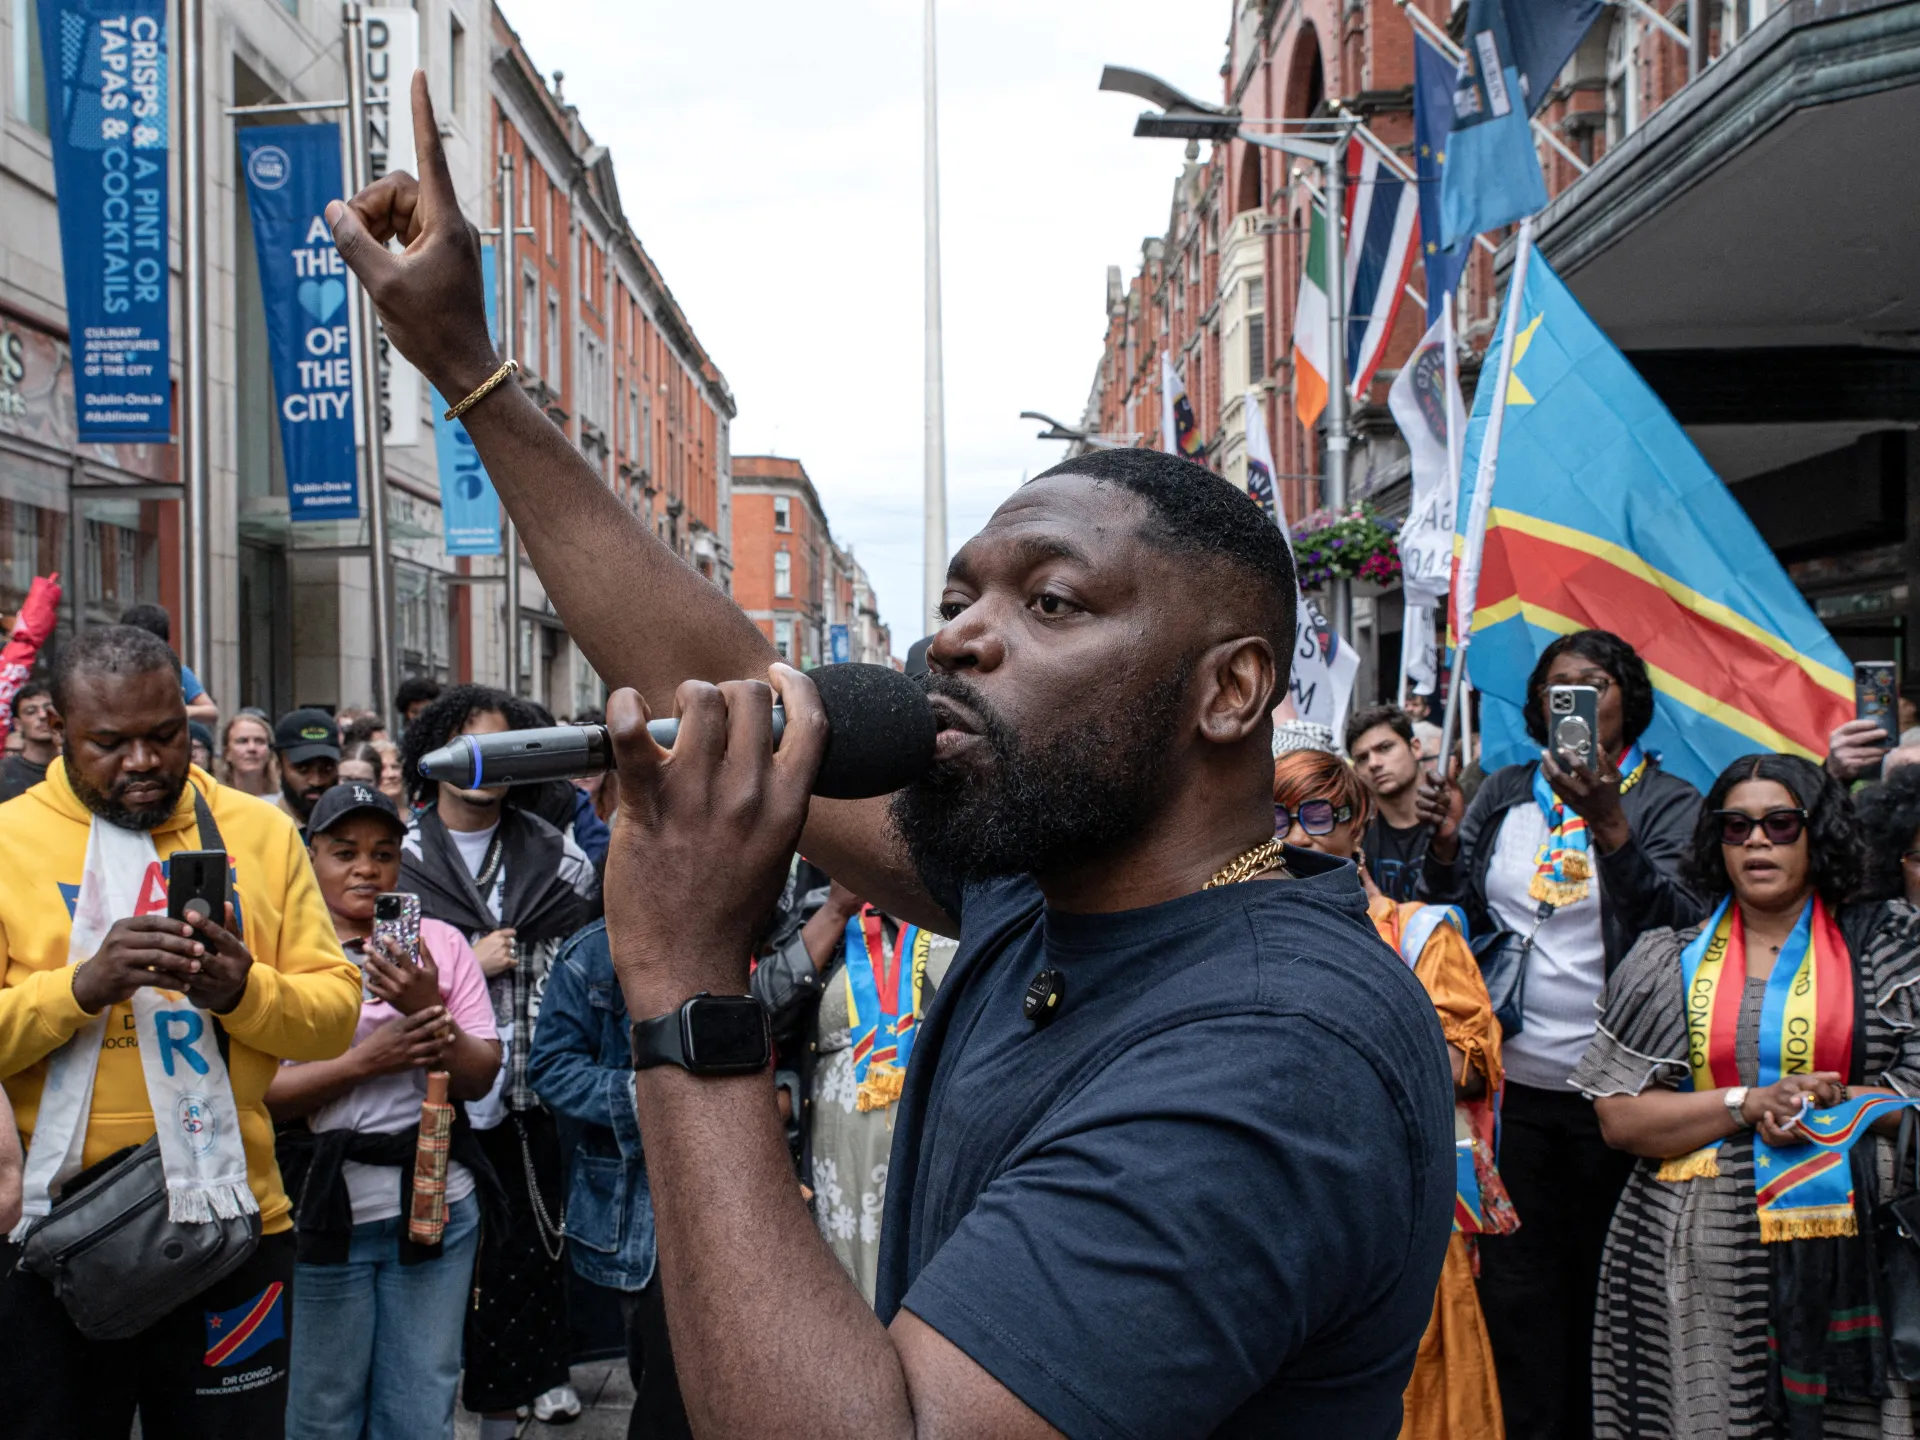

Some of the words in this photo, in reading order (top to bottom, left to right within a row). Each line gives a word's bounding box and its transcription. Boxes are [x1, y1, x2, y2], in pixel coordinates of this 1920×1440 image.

[100, 15, 128, 111] TAPAS
[131, 16, 159, 118] CRISPS
[366, 20, 389, 180] DUNNE
[102, 117, 129, 140] &
[132, 124, 160, 149] &
[133, 156, 159, 180] A
[102, 146, 130, 314] COCKTAILS
[133, 188, 160, 251] PINT
[305, 216, 335, 244] A
[292, 248, 345, 277] THE
[133, 257, 161, 302] OR
[84, 327, 141, 339] CULINARY
[84, 339, 160, 351] ADVENTURES
[306, 326, 348, 356] OF
[84, 352, 100, 363] AT
[102, 352, 125, 364] THE
[84, 365, 101, 377] OF
[103, 365, 126, 377] THE
[126, 364, 153, 377] CITY
[297, 358, 350, 388] THE
[283, 391, 350, 422] CITY
[353, 785, 373, 802] LA
[1704, 935, 1729, 962] RD
[124, 1014, 136, 1030] D
[1689, 978, 1713, 1069] CONGO
[154, 1010, 210, 1077] R
[1785, 1017, 1809, 1076] CON
[222, 1375, 238, 1386] DR
[238, 1365, 273, 1383] CONGO
